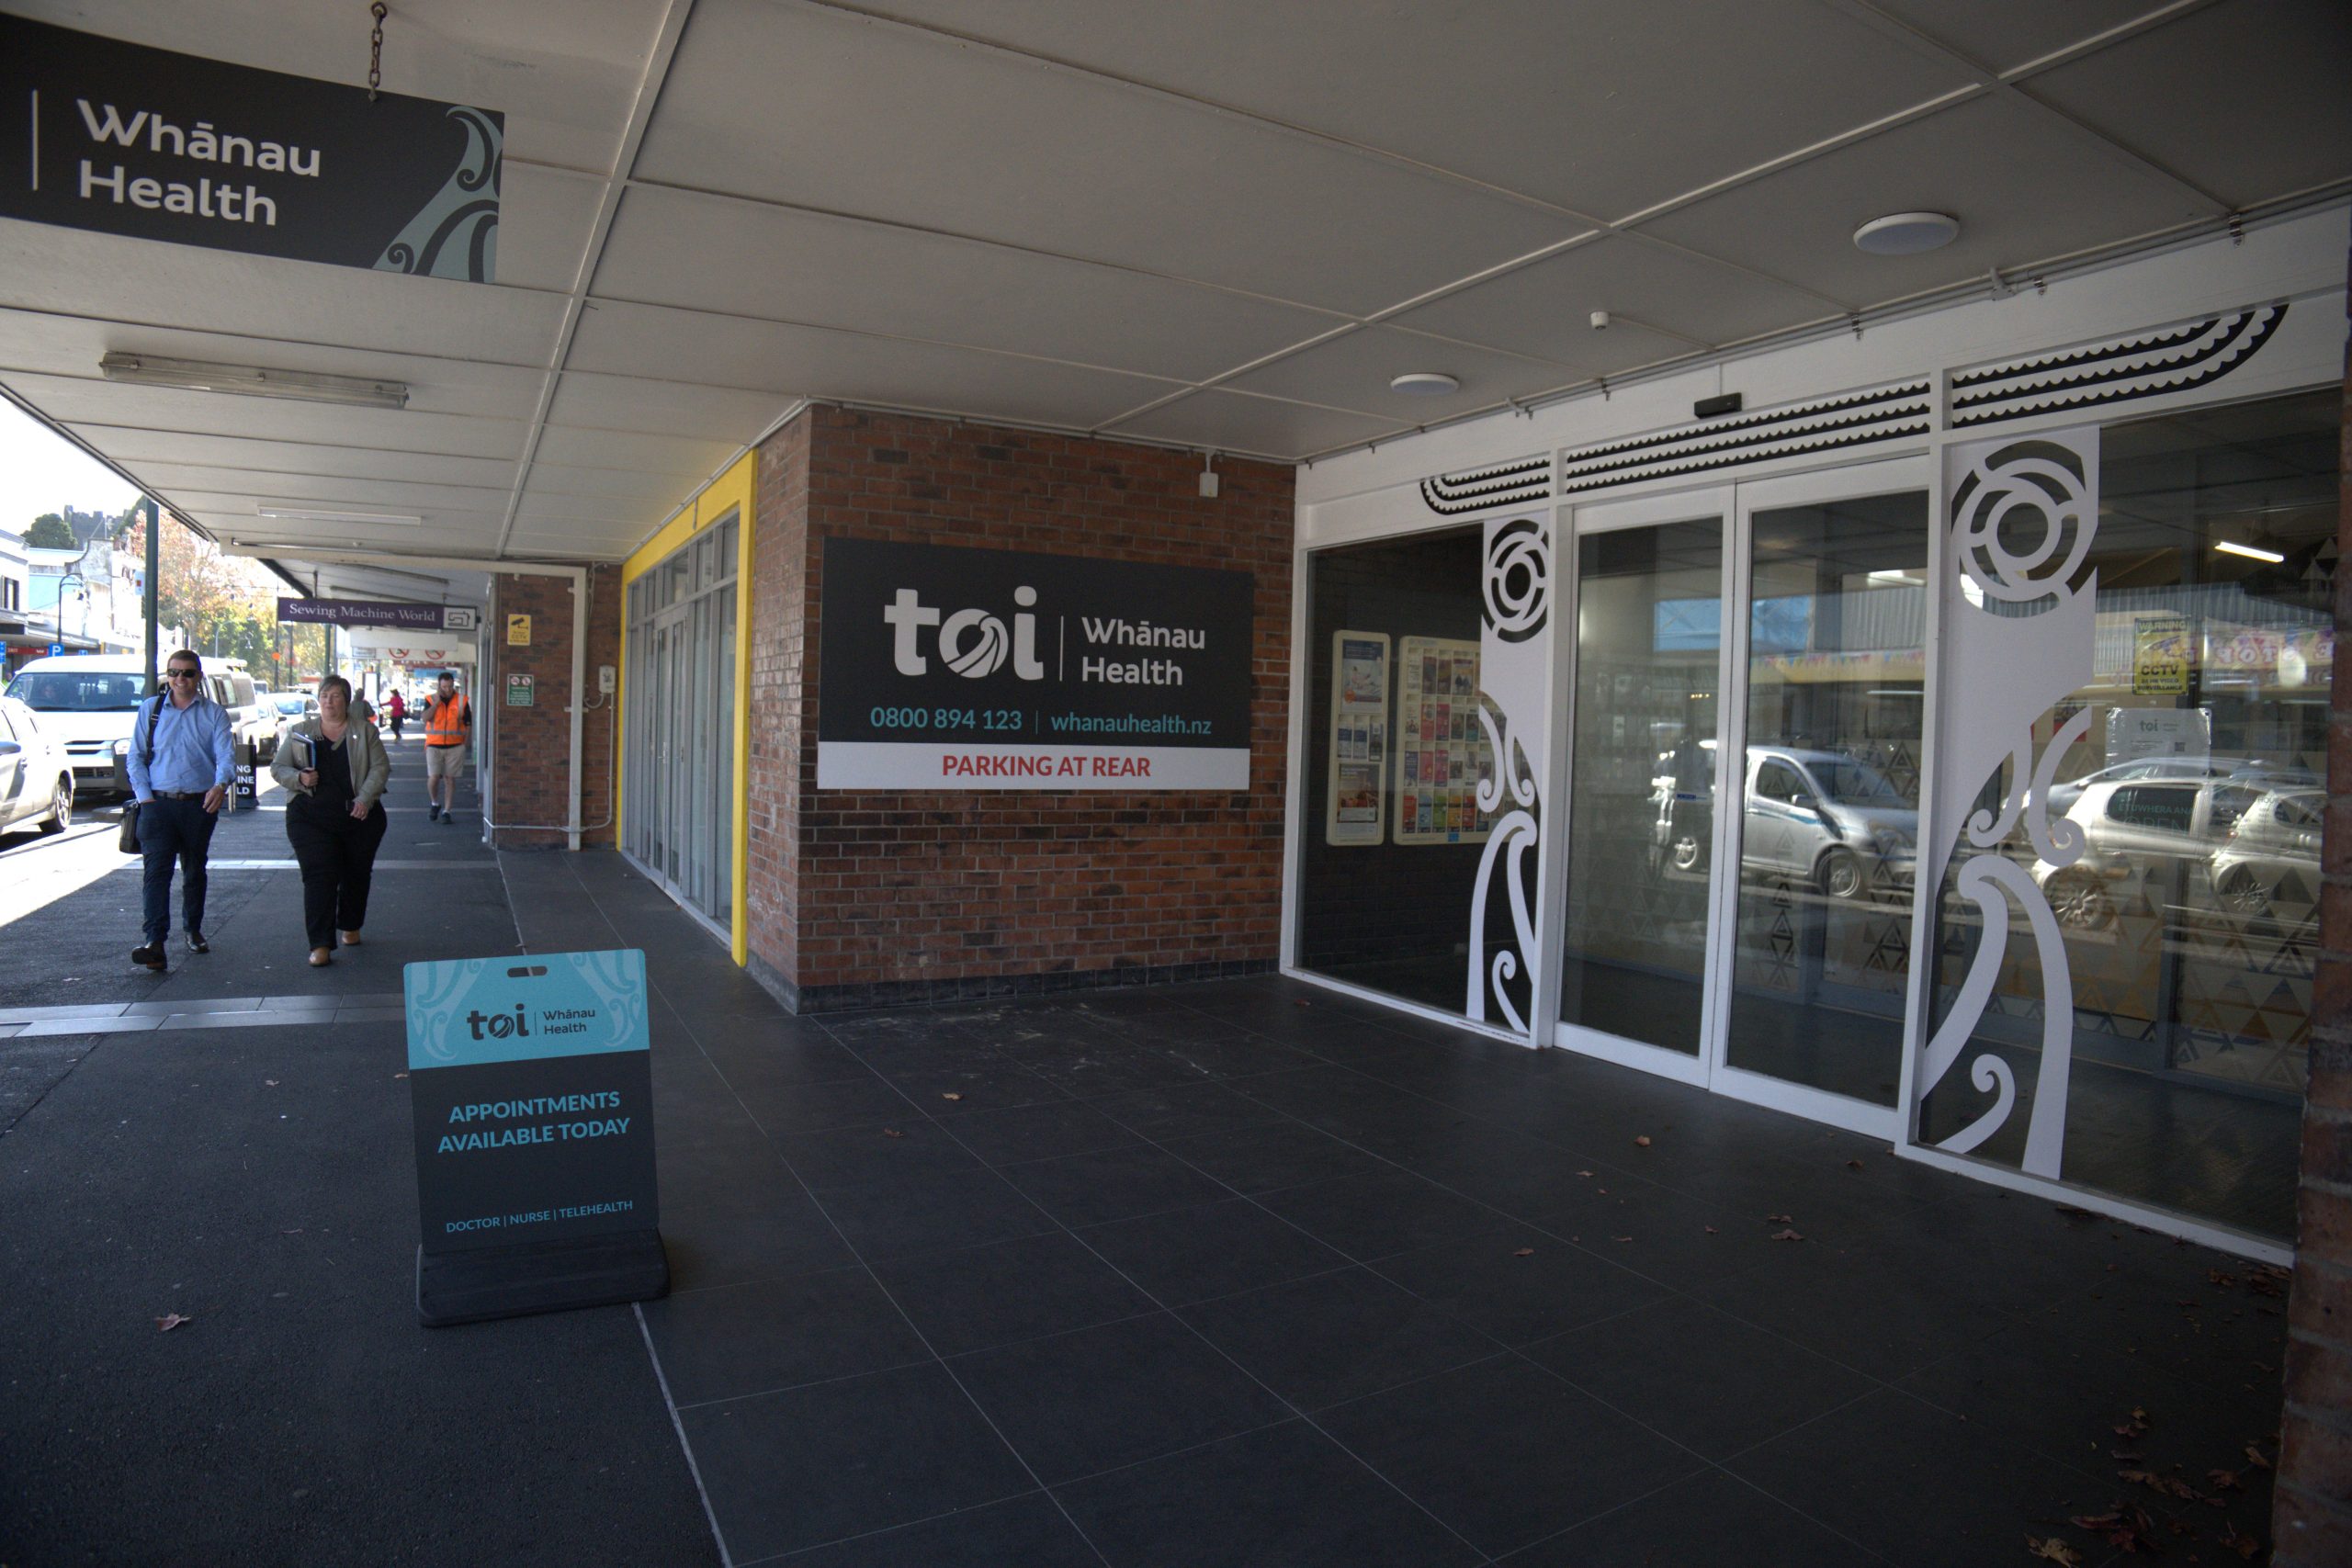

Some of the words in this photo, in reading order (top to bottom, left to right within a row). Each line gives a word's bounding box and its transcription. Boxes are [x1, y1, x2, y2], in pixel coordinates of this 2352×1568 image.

[78, 100, 320, 177] Whānau
[80, 160, 277, 226] Health
[289, 604, 336, 618] Sewing
[341, 606, 394, 618] Machine
[399, 610, 435, 621] World
[2140, 621, 2186, 630] WARNING
[885, 586, 1043, 680] toi
[1082, 617, 1204, 649] Whānau
[52, 646, 61, 657] P
[1082, 657, 1182, 685] Health
[2142, 665, 2179, 676] CCTV
[871, 707, 928, 728] 0800
[934, 709, 976, 728] 894
[983, 710, 1022, 729] 123
[1051, 712, 1211, 734] whanauhealth.nz
[944, 756, 1052, 776] PARKING
[1057, 757, 1087, 776] AT
[1093, 757, 1150, 776] REAR
[467, 1004, 529, 1040] toi
[543, 1010, 594, 1021] Whānau
[545, 1022, 586, 1034] Health
[449, 1092, 620, 1123] APPOINTMENTS
[437, 1125, 554, 1153] AVAILABLE
[558, 1118, 629, 1139] TODAY
[447, 1217, 500, 1233] DOCTOR
[510, 1211, 549, 1224] NURSE
[559, 1201, 632, 1218] TELEHEALTH
